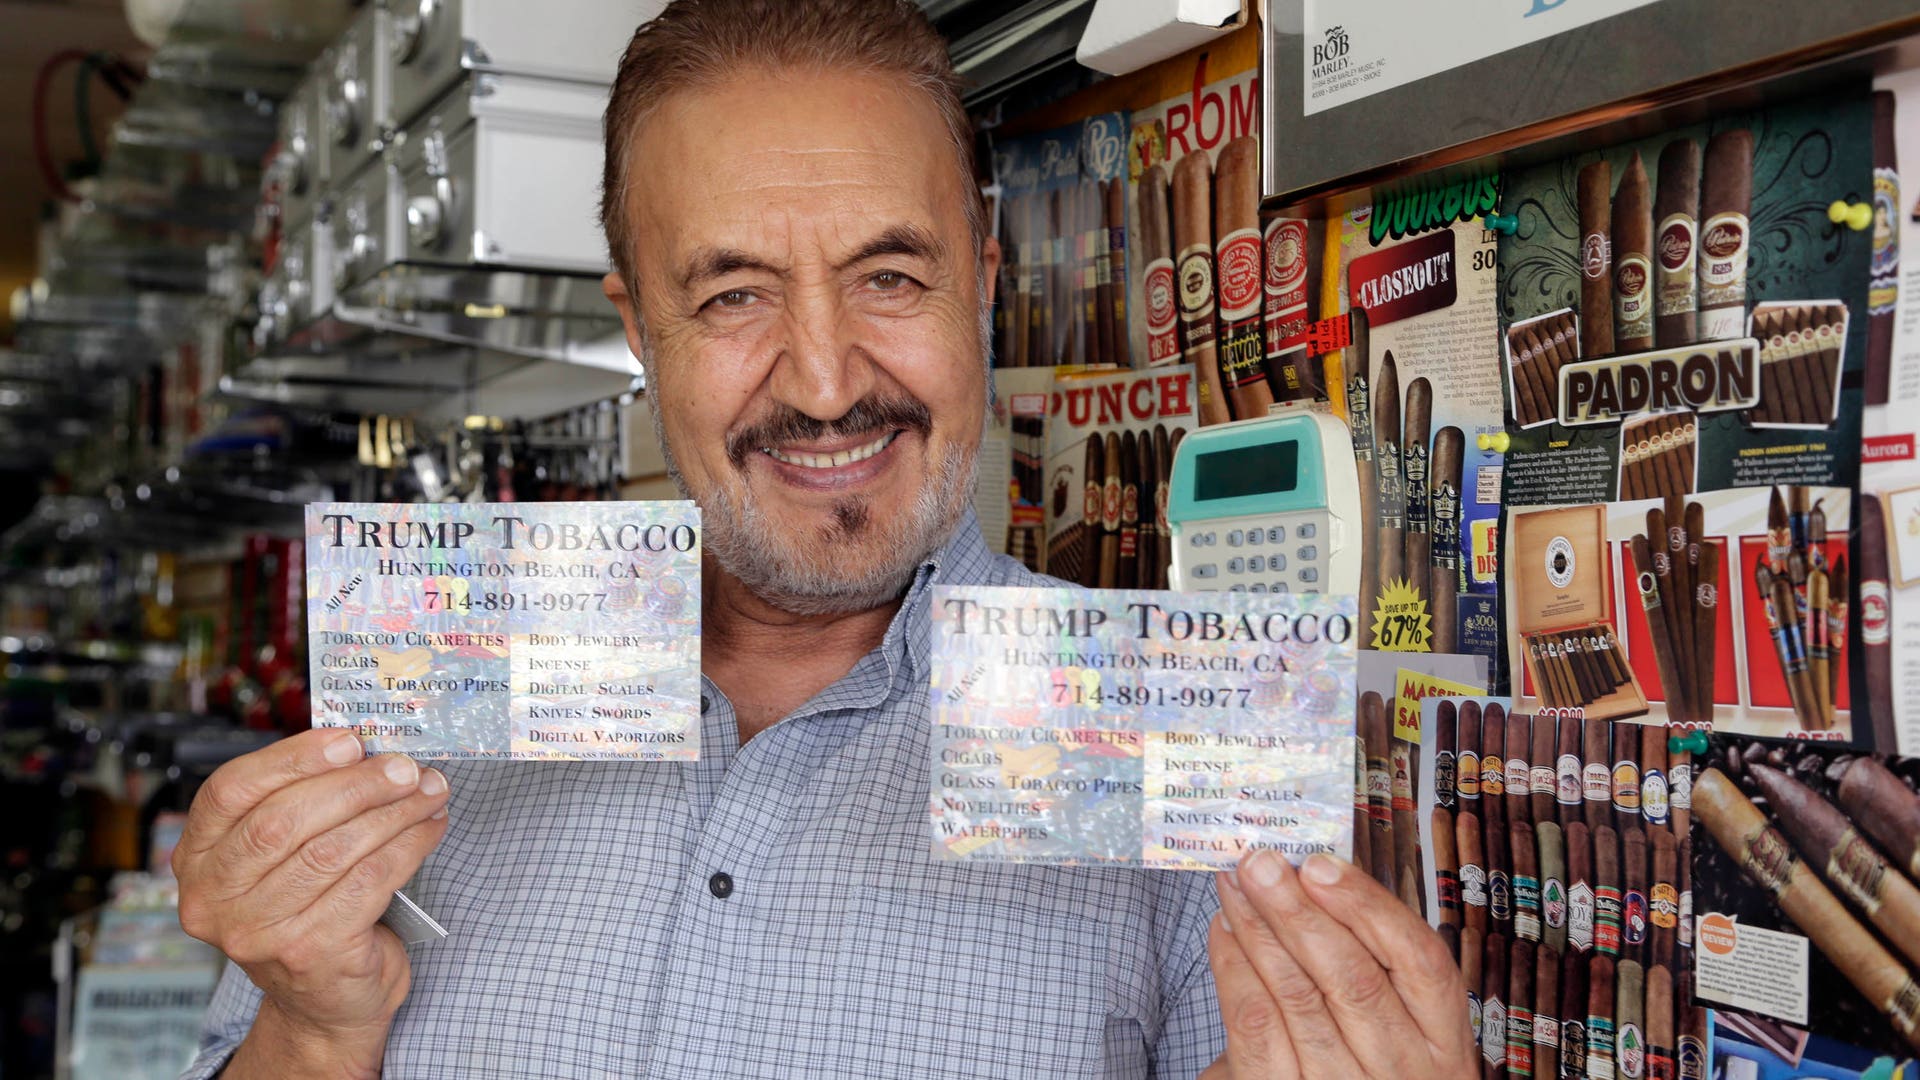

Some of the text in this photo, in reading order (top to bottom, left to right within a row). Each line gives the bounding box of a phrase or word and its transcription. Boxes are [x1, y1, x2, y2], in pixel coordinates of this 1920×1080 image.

[1312, 34, 1350, 67] BOB
[1312, 57, 1349, 80] MARLEY
[1361, 252, 1450, 309] CLOSEOUT
[1567, 351, 1752, 420] PADRON
[322, 514, 697, 552] TRUMP TOBACCO
[378, 560, 641, 580] HUNTINGTON BEACH, CA
[325, 573, 363, 614] All New
[423, 591, 607, 613] 714-891-9977
[1411, 602, 1419, 611] TO
[944, 599, 1352, 644] TRUMP TOBACCO
[1381, 614, 1422, 646] 67%
[321, 631, 504, 647] TOBACCO/ CIGARETTES
[529, 633, 641, 648] BODY JEWLERY
[321, 655, 379, 669] CIGARS
[529, 658, 591, 671] INCENSE
[1004, 649, 1290, 673] HUNTINGTON BEACH, CA
[321, 677, 510, 693] GLASS TOBACCO PIPES
[529, 682, 654, 696] DIGITAL SCALES
[1052, 684, 1251, 708] 714-891-9977
[321, 699, 416, 715] NOVELITIES
[591, 706, 652, 720] SWORDS
[529, 730, 685, 744] DIGITAL VAPORIZORS
[1031, 727, 1138, 744] CIGARETTES
[1164, 731, 1289, 749] BODY JEWLERY
[941, 749, 1003, 765] CIGARS
[1164, 758, 1233, 773] INCENSE
[941, 773, 1143, 794] GLASS TOBACCO PIPES
[1164, 784, 1302, 801] DIGITAL SCALES
[941, 798, 1041, 816] NOVELITIES
[1232, 812, 1299, 827] SWORDS
[941, 822, 1048, 840] WATERPIPES
[1164, 836, 1336, 855] DIGITAL VAPORIZORS
